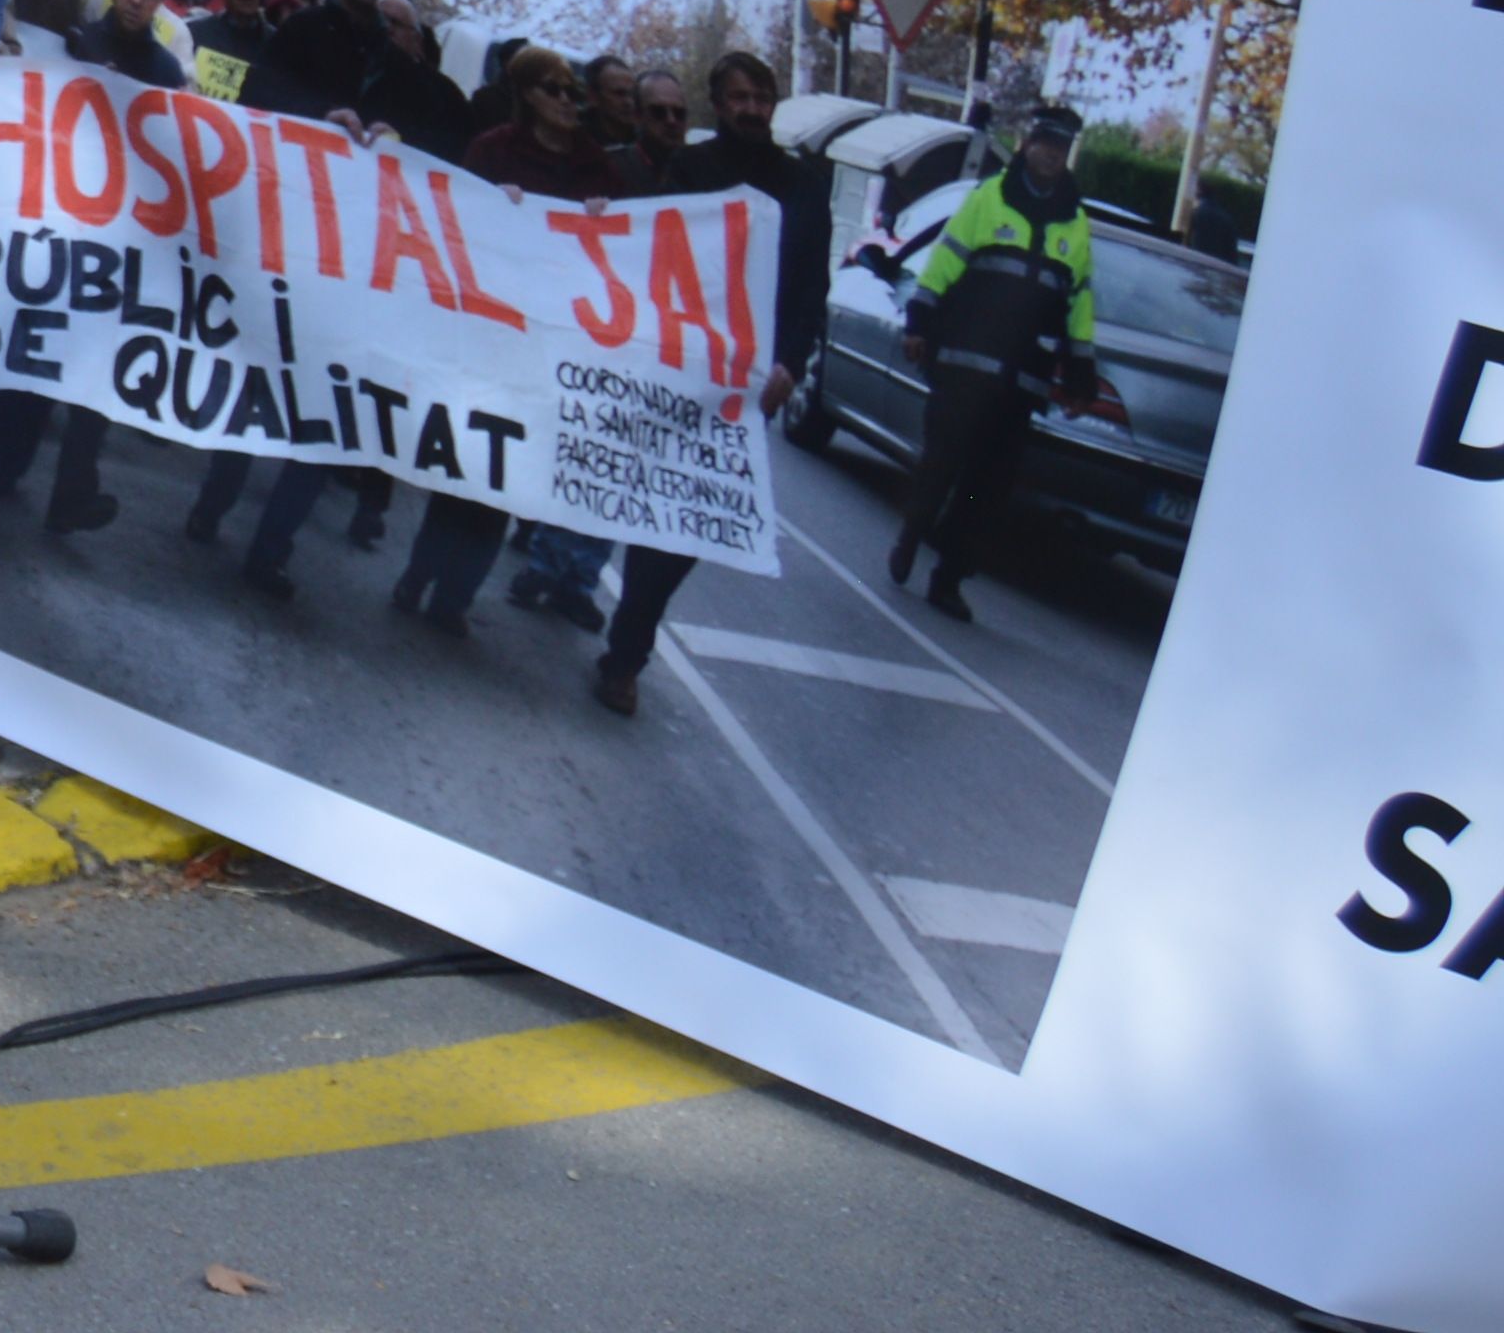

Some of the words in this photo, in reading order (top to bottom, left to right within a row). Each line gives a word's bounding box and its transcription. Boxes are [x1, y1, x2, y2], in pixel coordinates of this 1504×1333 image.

[546, 200, 756, 422] JA!
[113, 335, 526, 492] QUALITAT
[559, 395, 588, 430] LA
[711, 414, 750, 453] PER
[552, 470, 660, 533] MONTCADA
